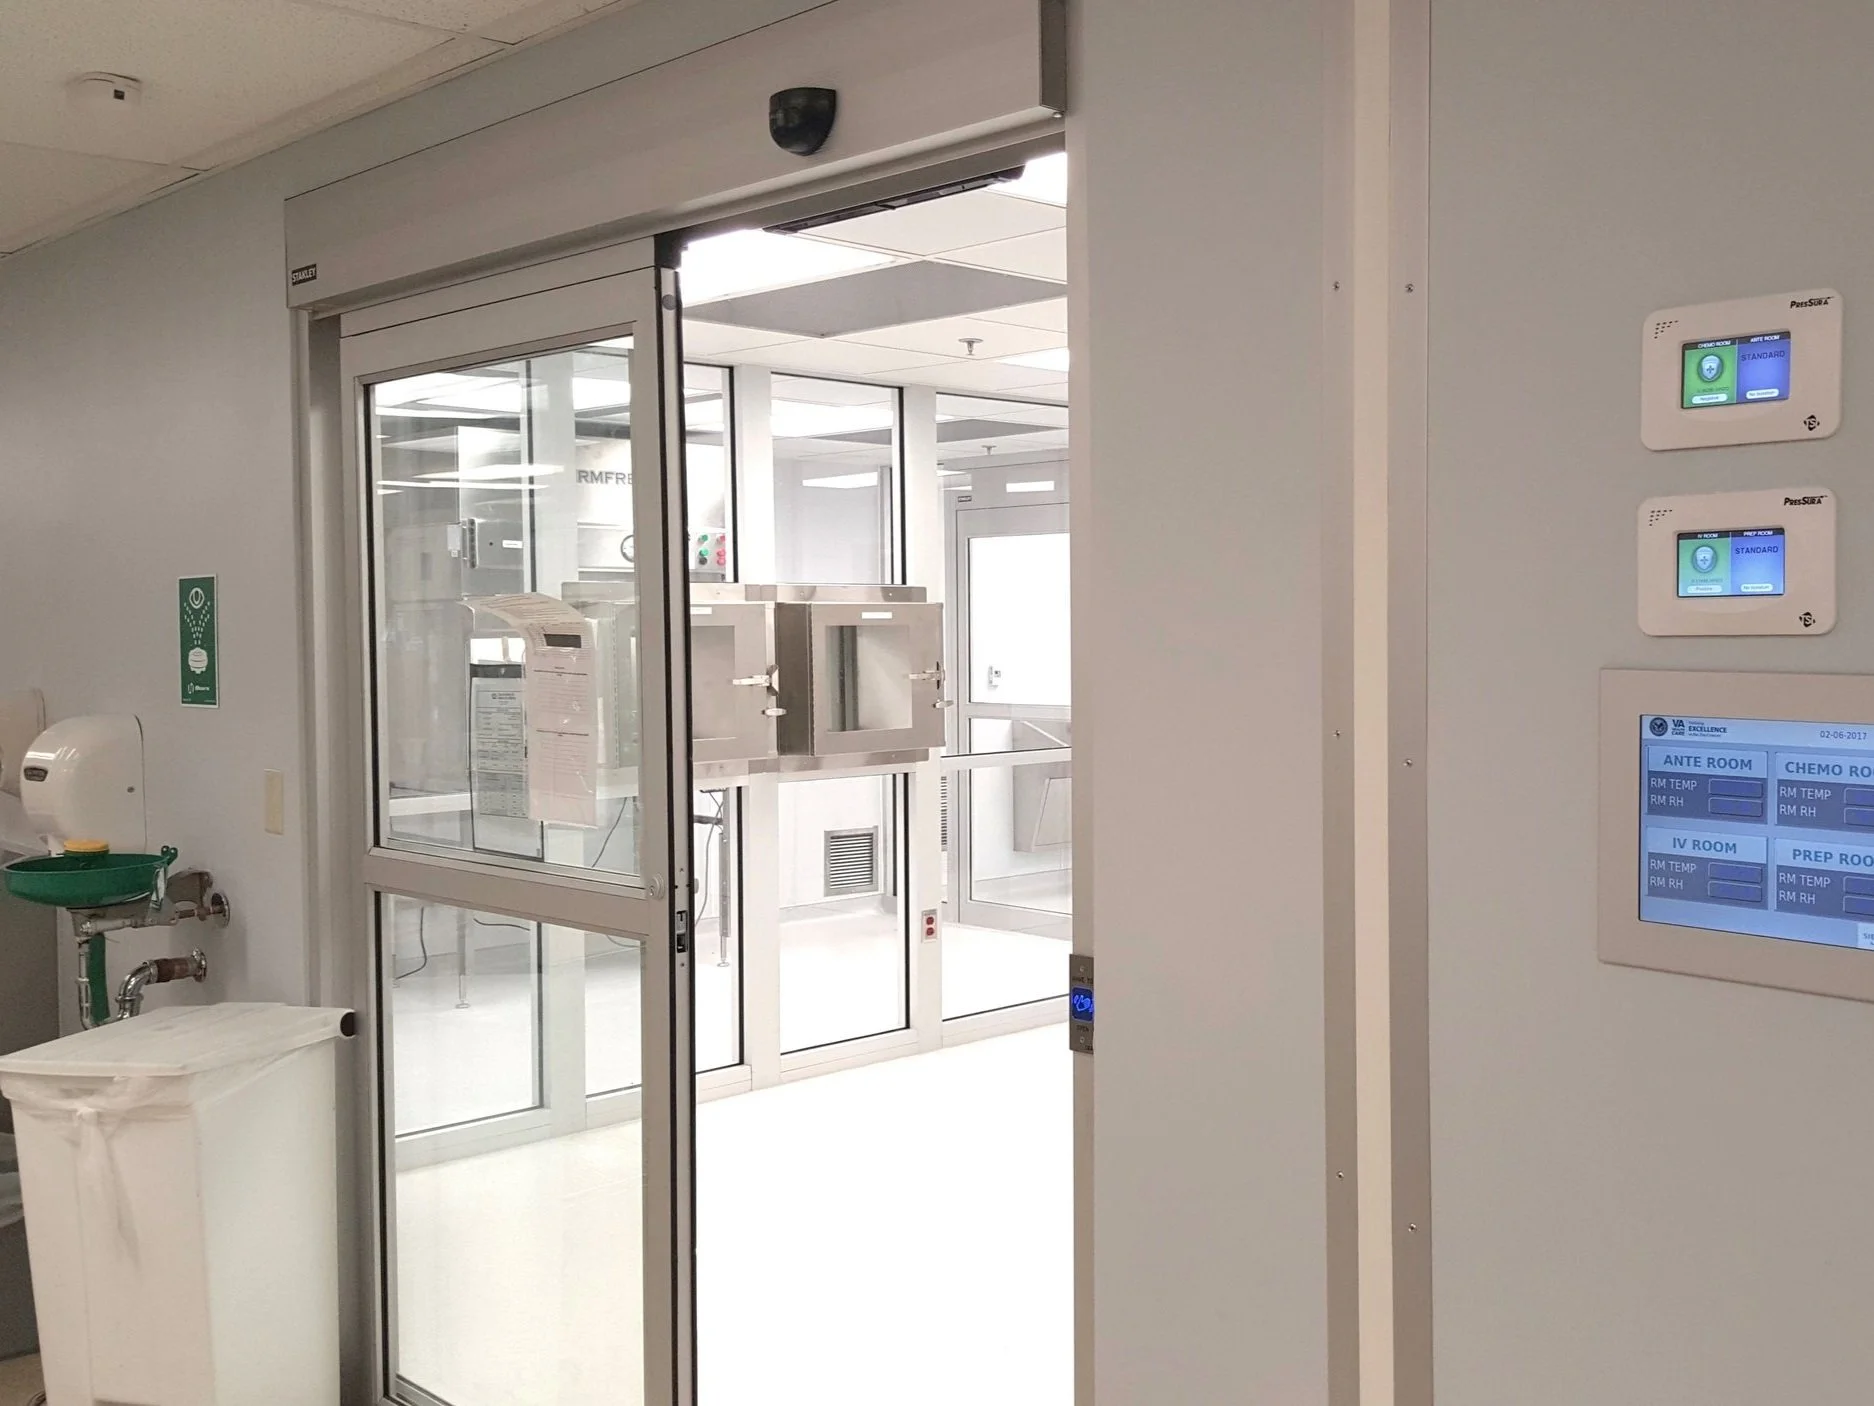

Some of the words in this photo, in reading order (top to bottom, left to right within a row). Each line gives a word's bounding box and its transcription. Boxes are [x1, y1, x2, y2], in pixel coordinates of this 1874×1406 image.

[292, 266, 316, 283] STANLEY
[1741, 350, 1785, 361] STANDARD
[1735, 546, 1779, 554] STANDARD
[1672, 719, 1685, 728] VA
[1688, 725, 1728, 733] EXCELLENCE
[1820, 730, 1867, 740] 02-06-2017
[1664, 754, 1701, 767] ANTE
[1707, 757, 1752, 770] ROOM
[1785, 761, 1843, 776] CHEMO
[1849, 765, 1874, 778] RO
[1650, 778, 1666, 788] RM
[1669, 779, 1697, 791] TEMP
[1780, 786, 1797, 798] RM
[1800, 787, 1831, 800] TEMP
[1650, 794, 1666, 805] RM
[1669, 796, 1684, 807] RH
[1780, 804, 1796, 816] RM
[1800, 806, 1816, 817] RH
[1673, 837, 1687, 849] IV
[1692, 839, 1737, 854] ROOM
[1793, 848, 1833, 863] PREP
[1650, 859, 1666, 871] RM
[1668, 861, 1697, 873] TEMP
[1650, 876, 1666, 888] RM
[1668, 878, 1684, 890] RH
[1779, 872, 1796, 885] RM
[1800, 874, 1831, 888] TEMP
[1779, 890, 1796, 903] RM
[1800, 892, 1816, 905] RH
